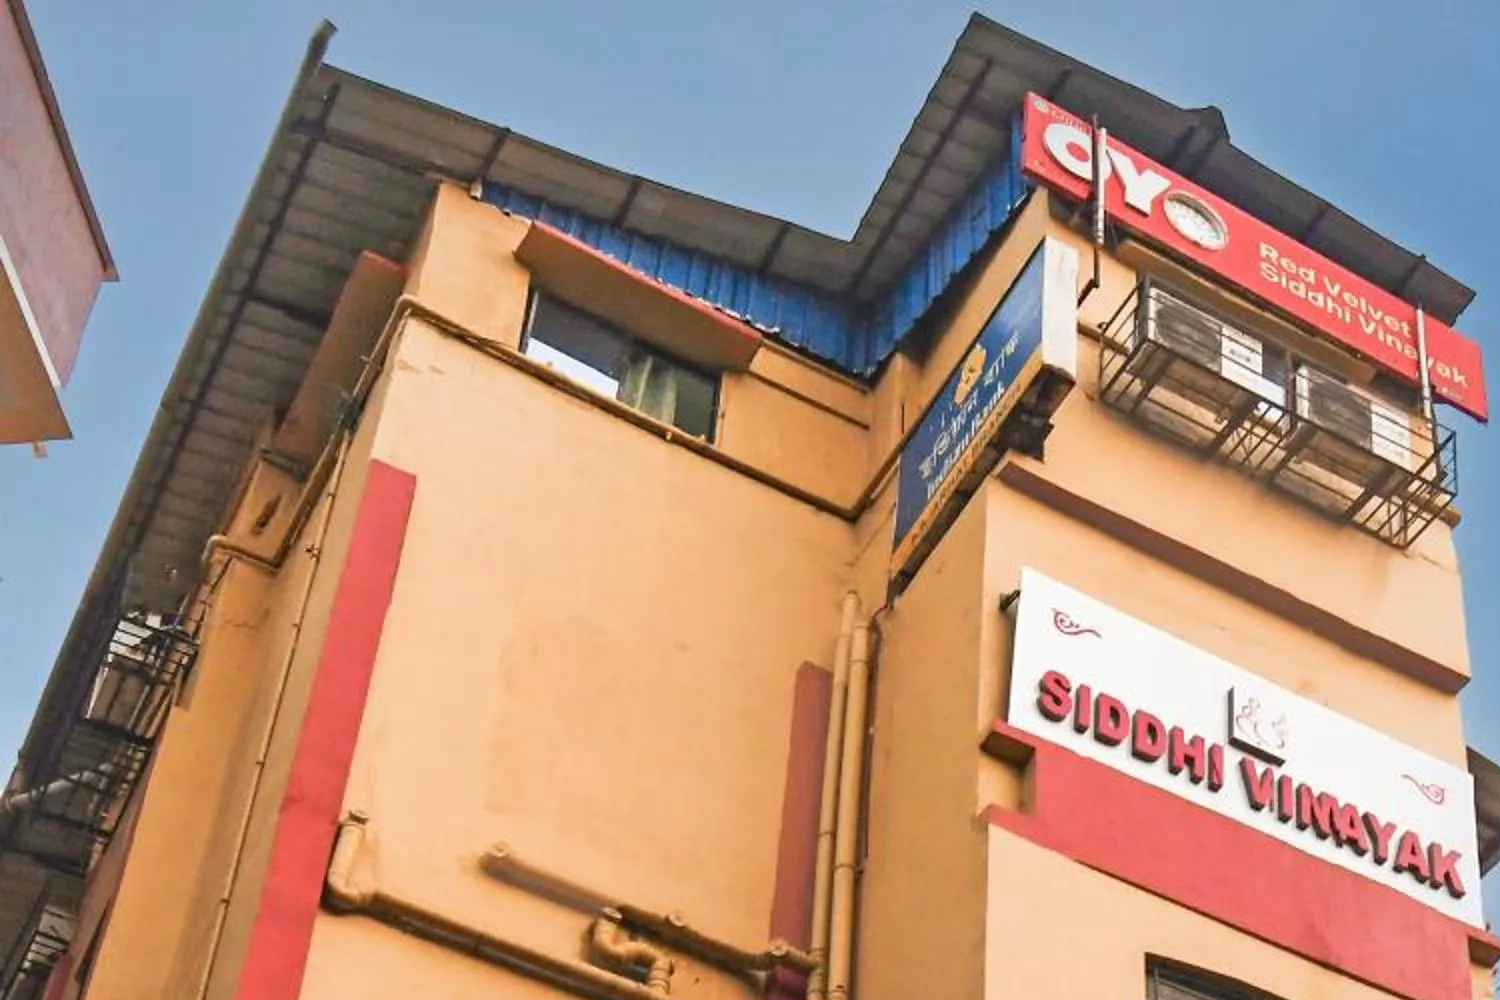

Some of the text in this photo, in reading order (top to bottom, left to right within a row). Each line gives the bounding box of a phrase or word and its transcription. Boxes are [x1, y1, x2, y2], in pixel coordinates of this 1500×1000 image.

[1042, 119, 1231, 253] OYO
[1257, 240, 1414, 342] Red Velvet
[1257, 260, 1352, 327] Siddhi
[1037, 669, 1466, 899] SIDDHI VINAYAK
